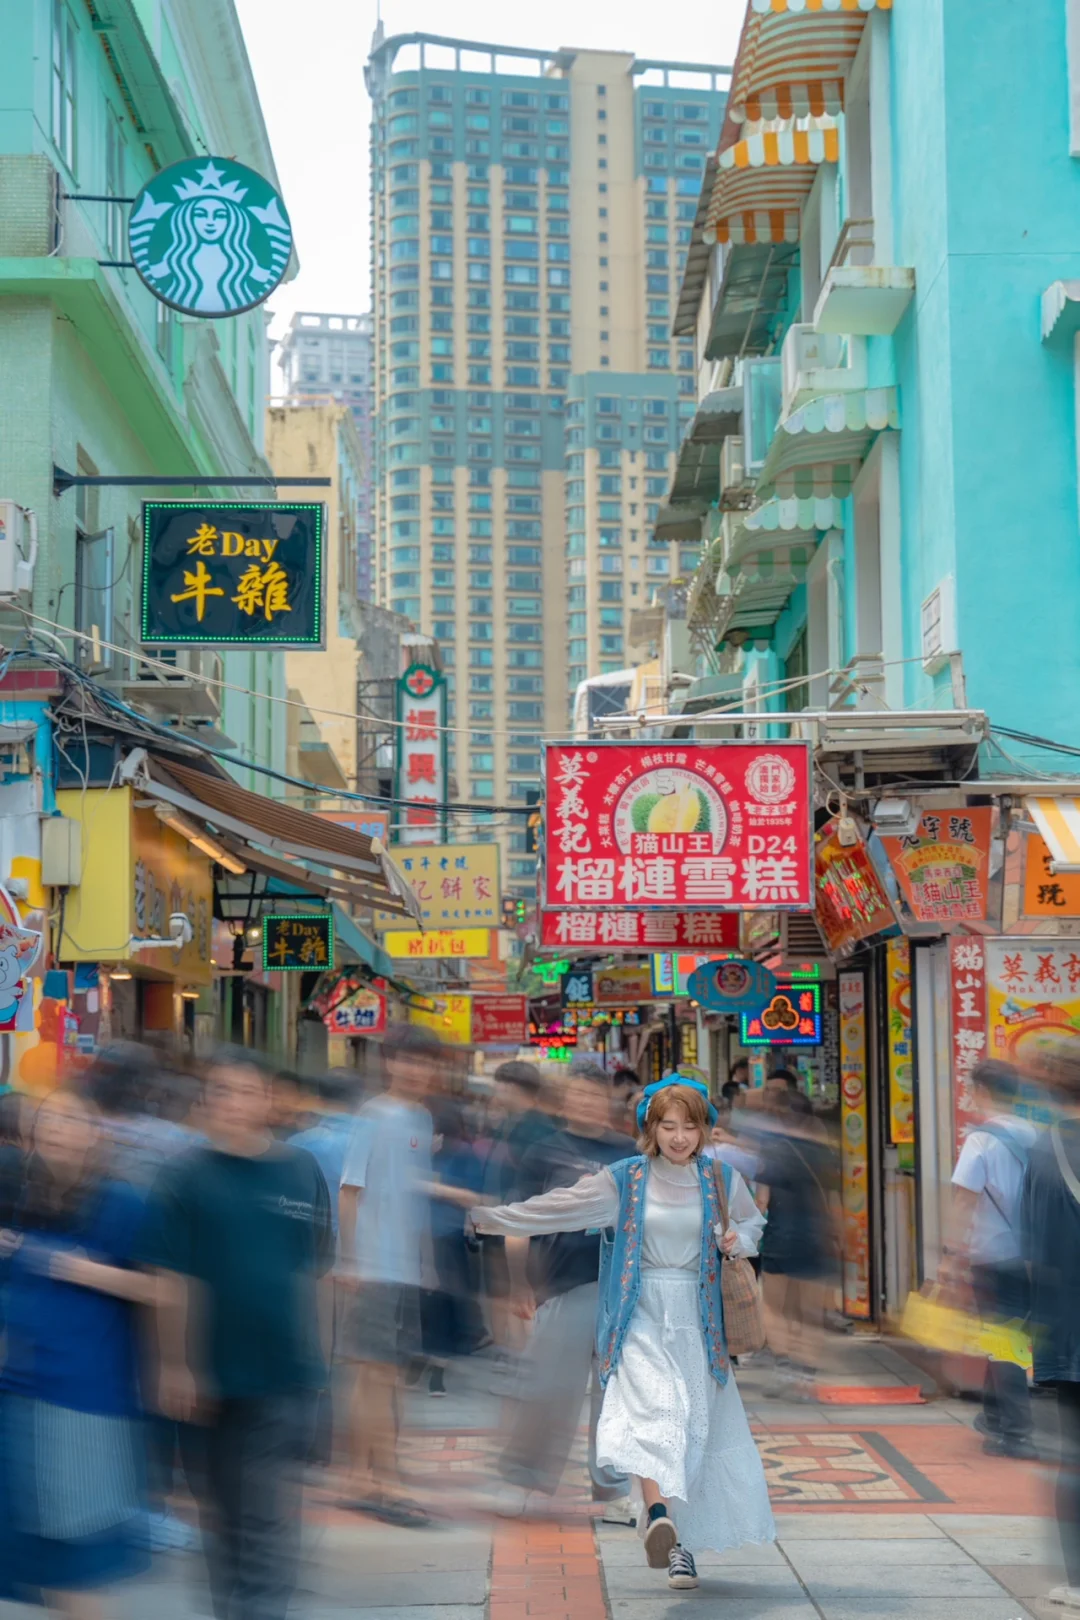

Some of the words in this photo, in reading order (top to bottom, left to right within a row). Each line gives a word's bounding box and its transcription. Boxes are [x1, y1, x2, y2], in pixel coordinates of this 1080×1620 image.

[186, 522, 279, 563] 老Day
[170, 560, 293, 622] 牛雜
[552, 752, 591, 853] 莫義記
[748, 835, 798, 854] D24
[556, 856, 800, 902] 榴槤雪糕
[276, 919, 321, 940] 老Day
[555, 911, 723, 944] 榴槤雪糕
[268, 936, 328, 966] 牛雜
